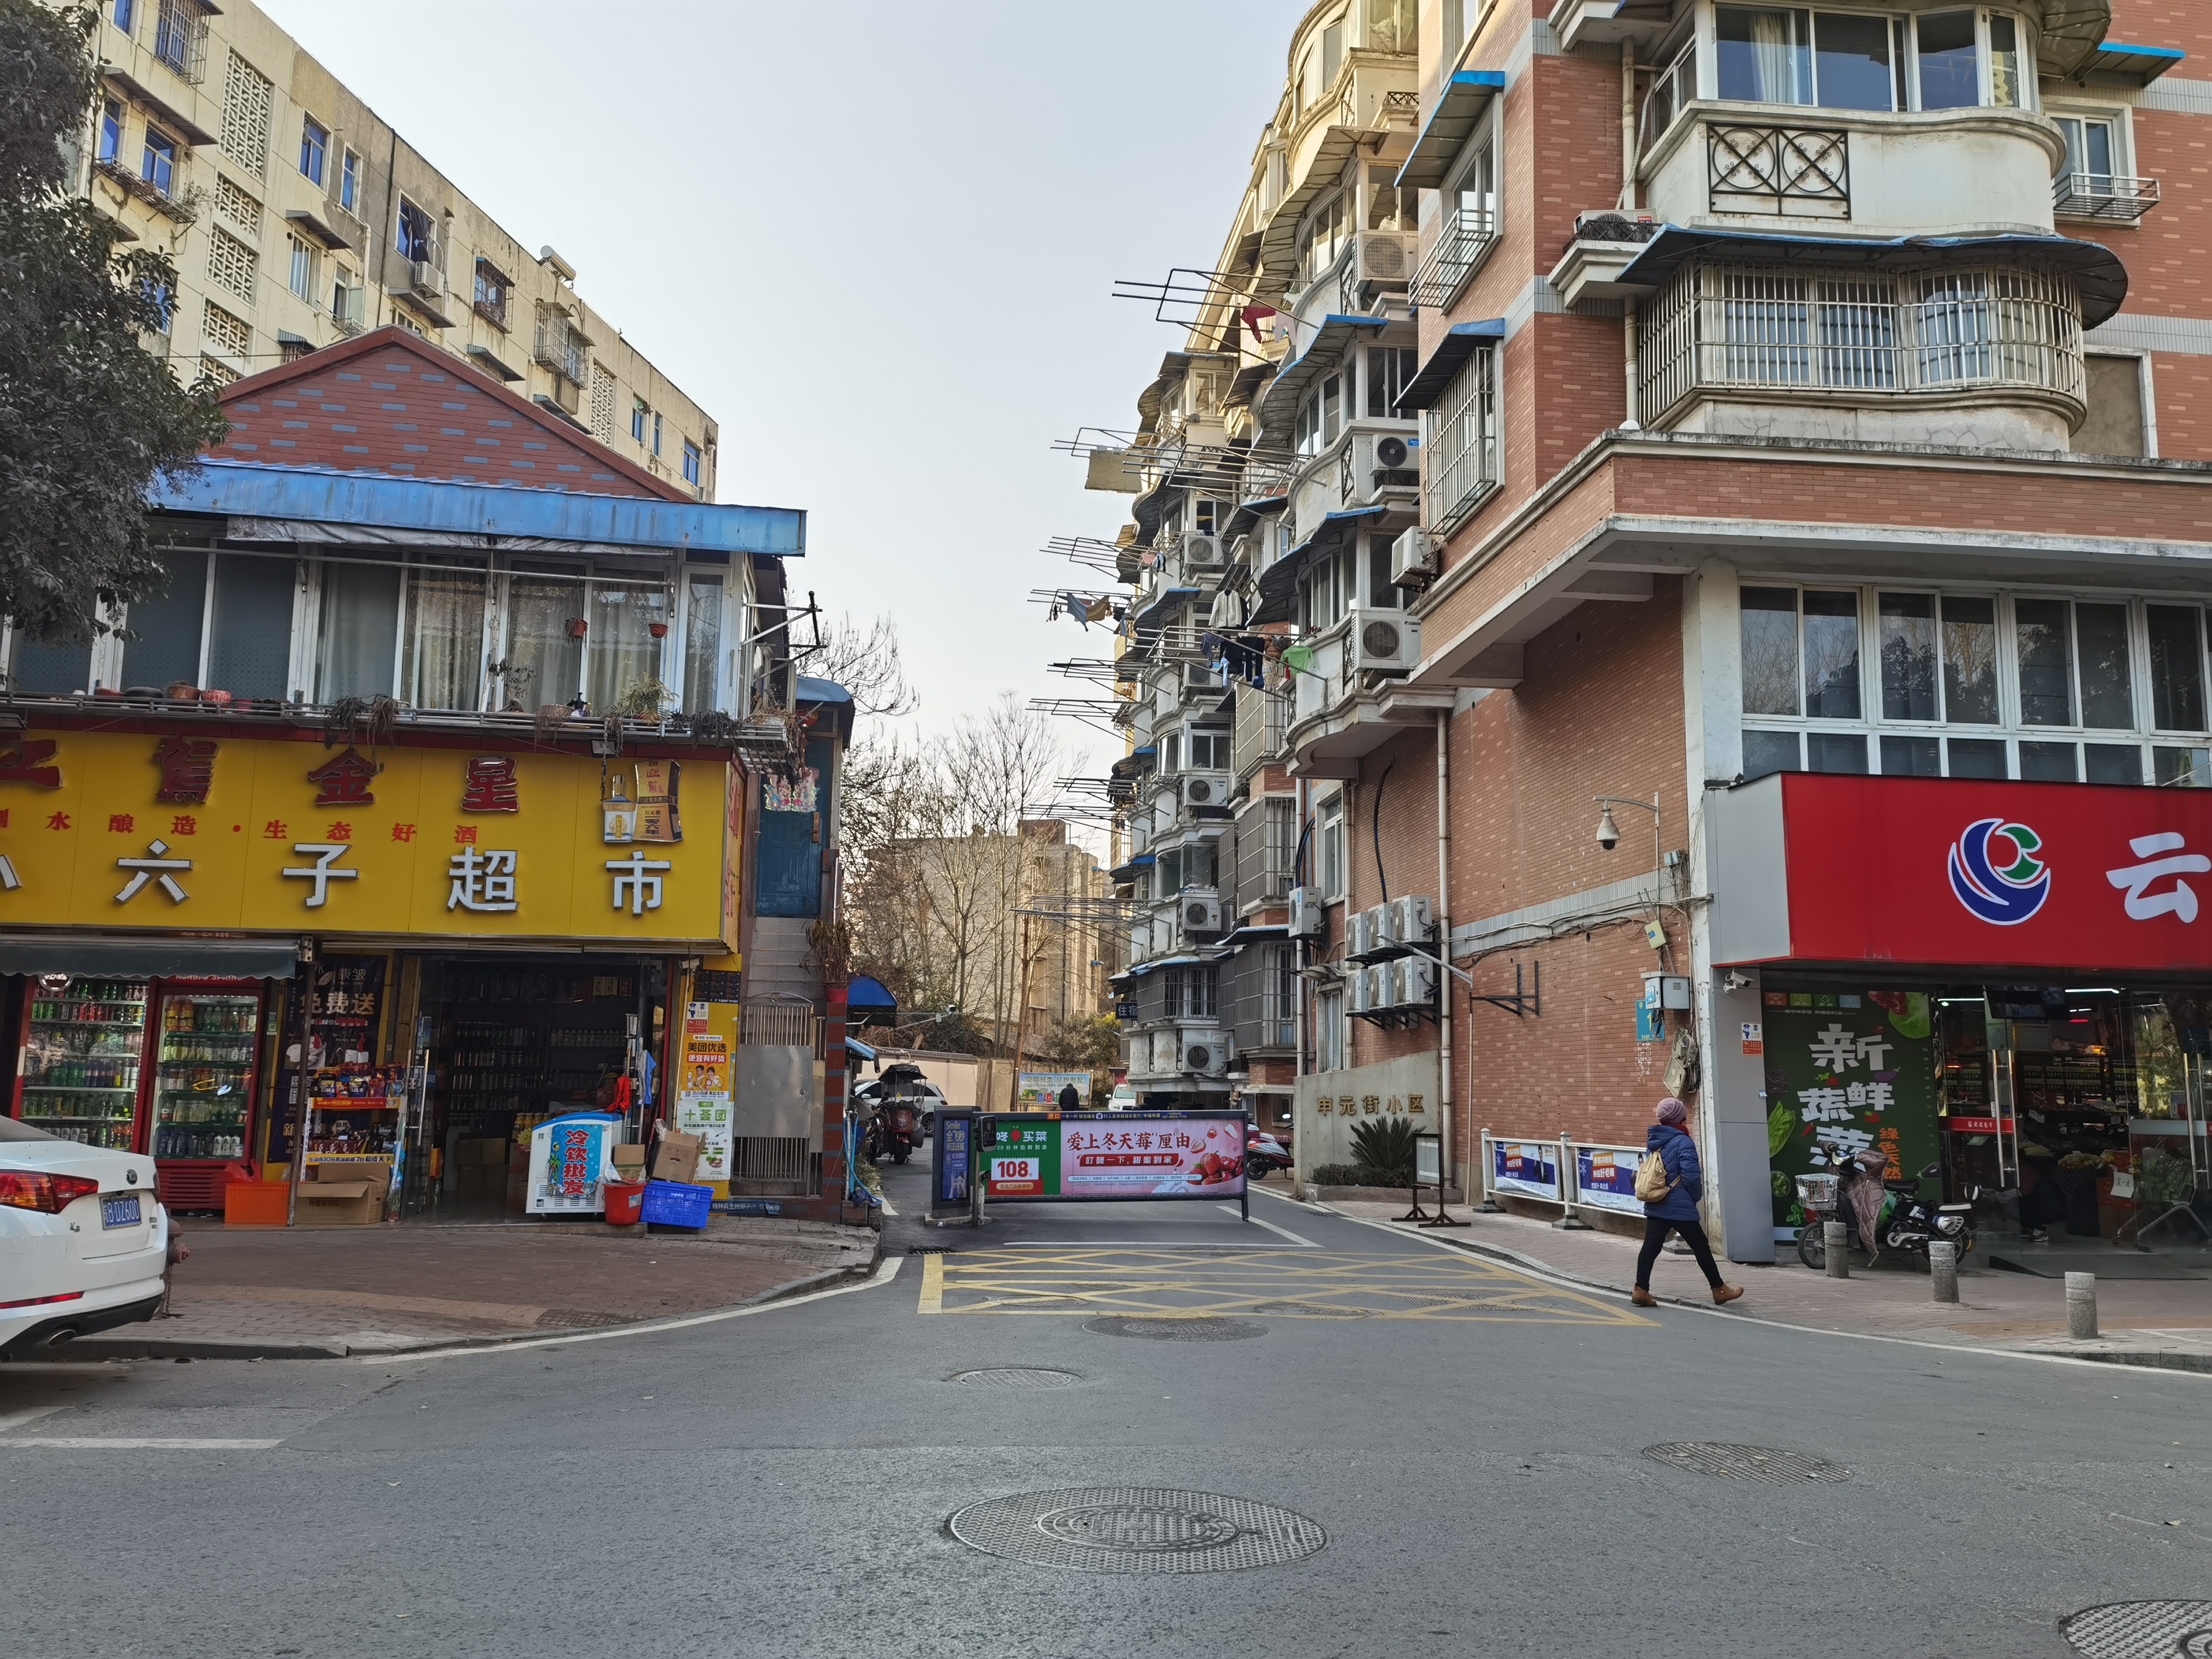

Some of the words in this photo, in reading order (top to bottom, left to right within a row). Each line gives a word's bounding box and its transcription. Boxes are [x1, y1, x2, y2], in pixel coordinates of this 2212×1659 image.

[2106, 832, 2211, 923] 云
[299, 992, 375, 1015] 免费送
[687, 1042, 727, 1053] 美团优选
[1809, 1023, 1893, 1073] 新
[689, 1054, 725, 1062] 便宜有好货
[1318, 1094, 1424, 1115] 申元街小区
[684, 1109, 727, 1121] 十荟团
[946, 1121, 960, 1130] Smile
[946, 1130, 965, 1142] 全飞秒
[562, 1129, 590, 1195] 冷饮批发
[997, 1161, 1029, 1178] 108
